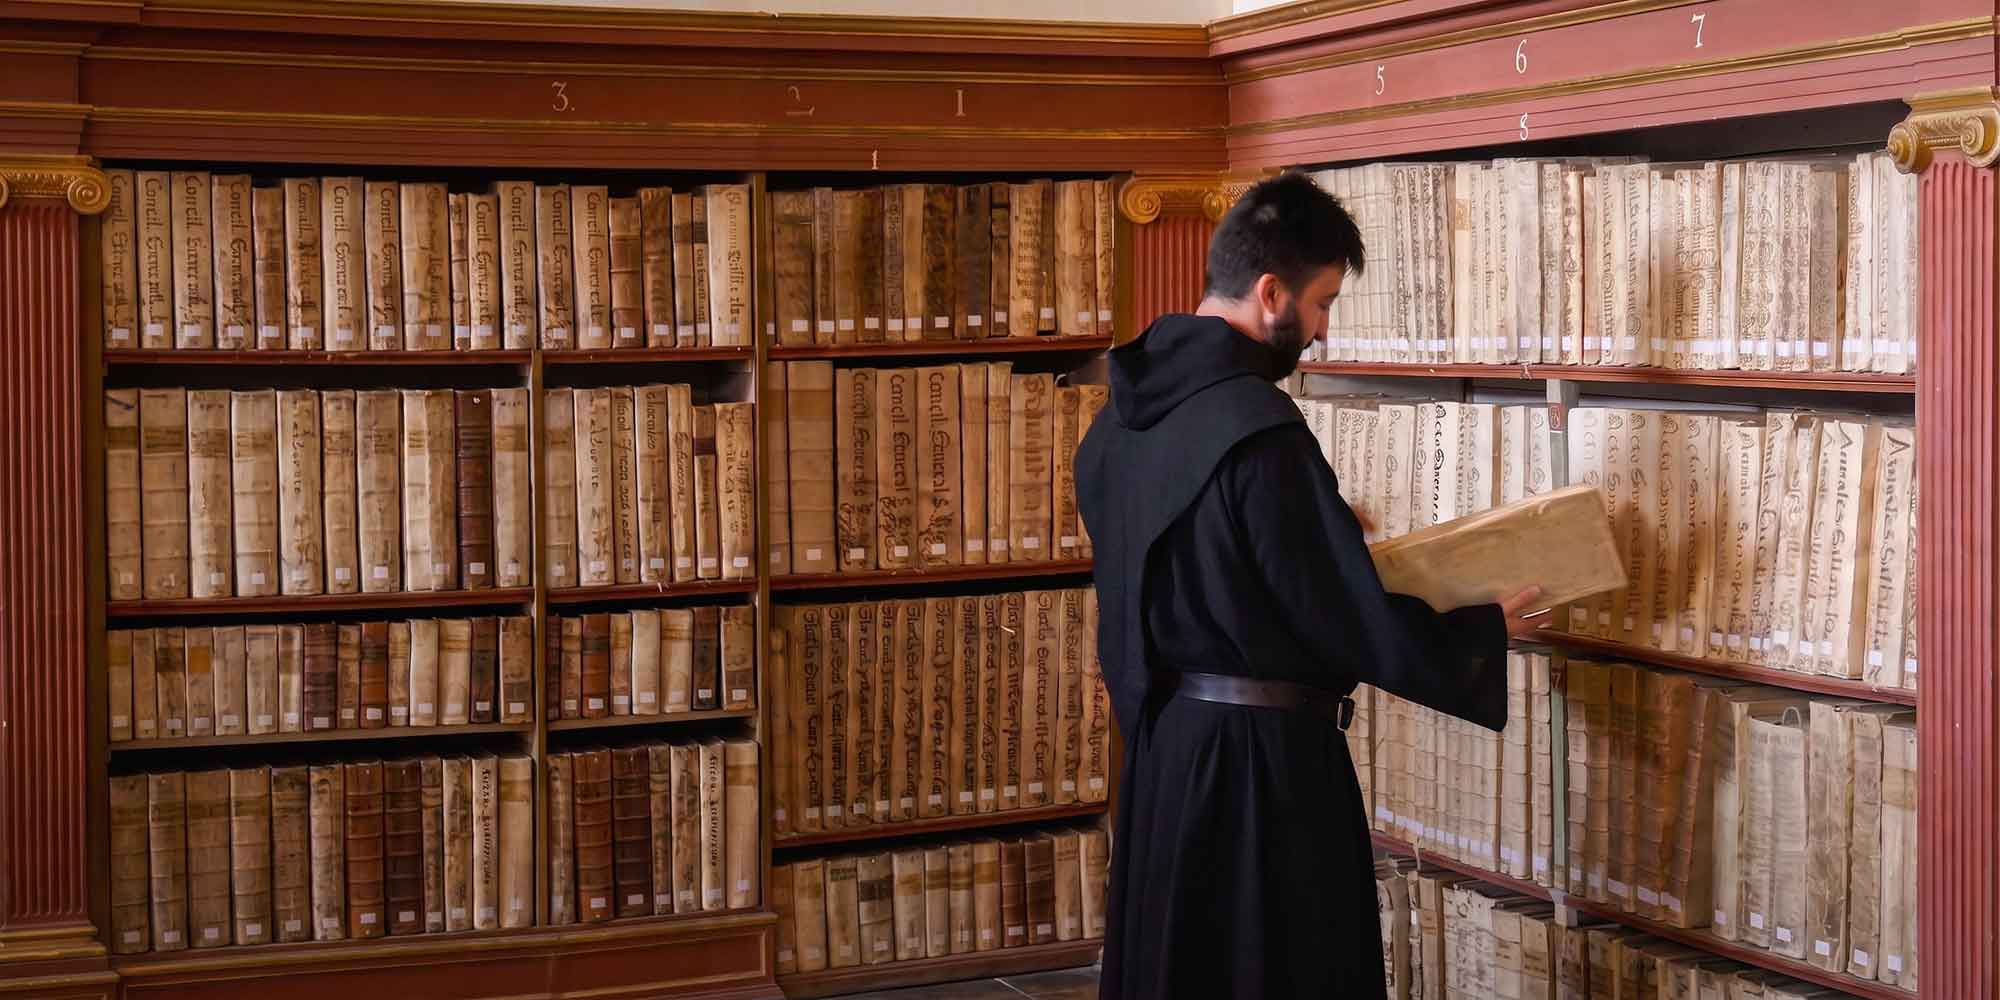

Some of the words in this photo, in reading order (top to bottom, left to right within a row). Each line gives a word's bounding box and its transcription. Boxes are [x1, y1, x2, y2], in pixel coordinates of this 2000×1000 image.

[1691, 13, 1705, 48] 7
[1515, 39, 1527, 74] 6
[1375, 65, 1385, 95] 5
[955, 88, 967, 117] 1
